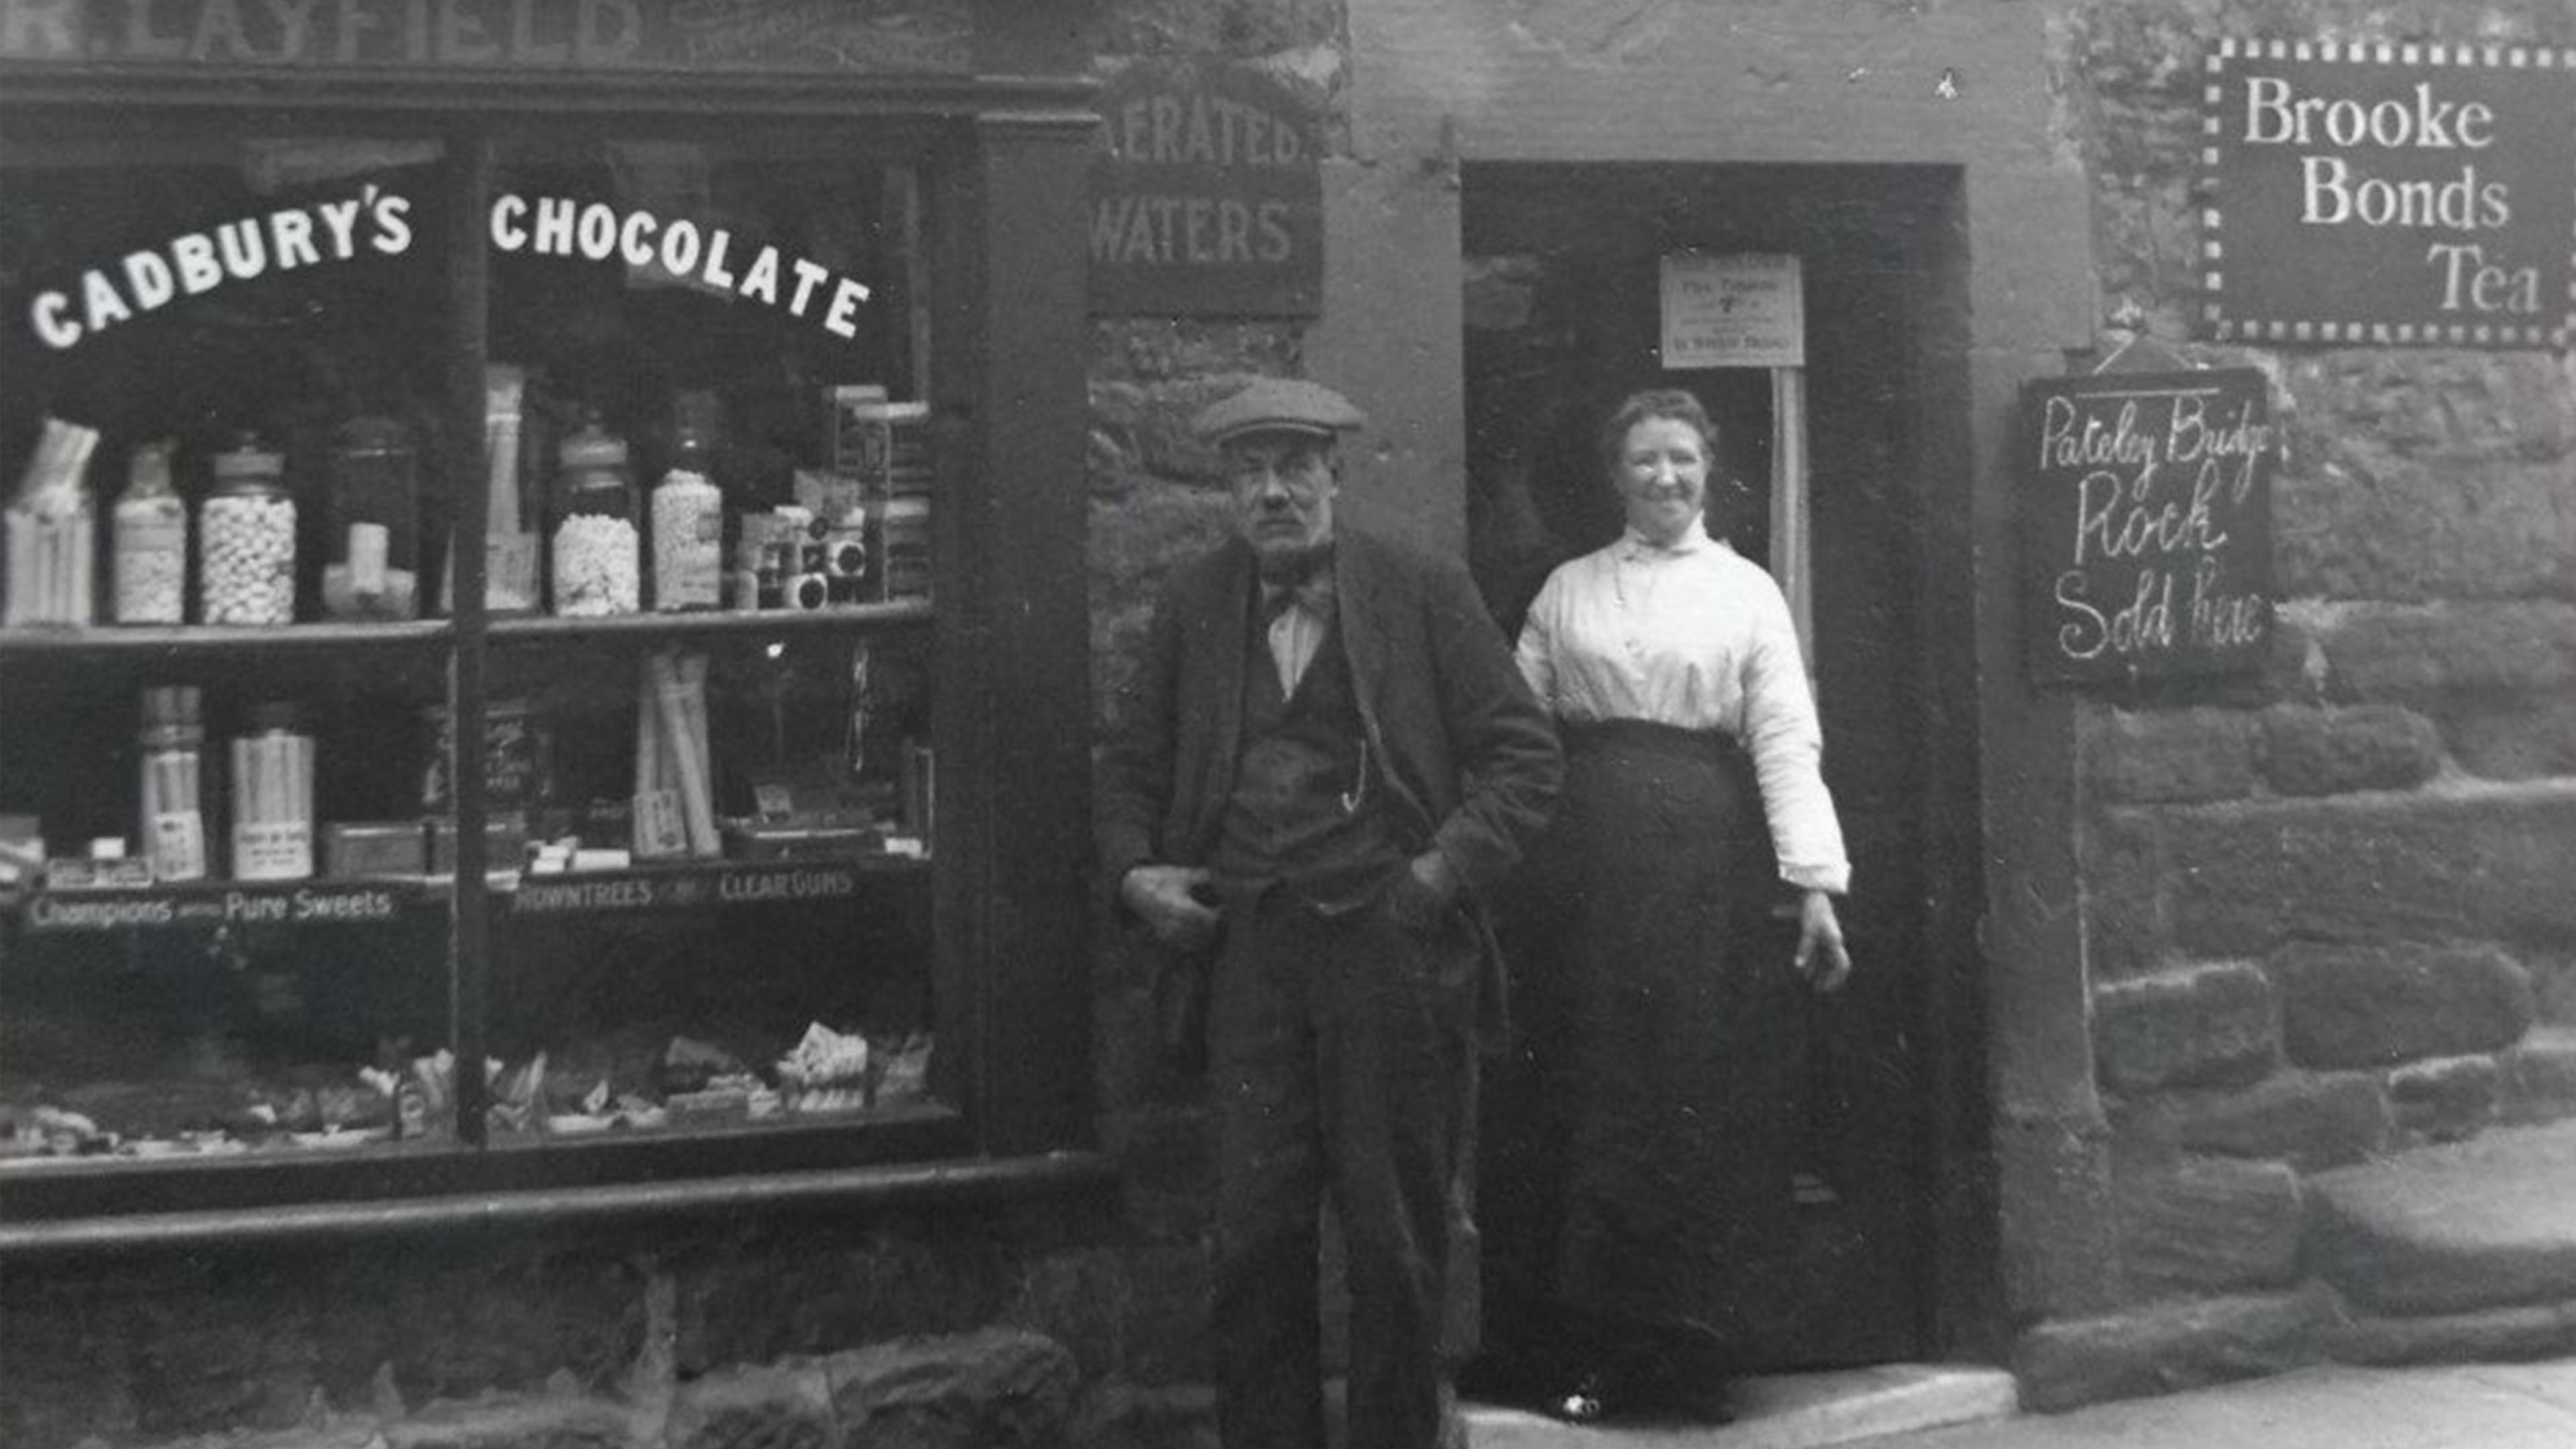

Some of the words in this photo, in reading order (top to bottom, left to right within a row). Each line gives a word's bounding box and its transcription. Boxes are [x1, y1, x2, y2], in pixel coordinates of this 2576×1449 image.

[125, 0, 641, 63] LAYFIELD
[2243, 76, 2494, 147] Brooke
[1087, 195, 1291, 263] WATERS
[2300, 155, 2511, 230] Bonds
[31, 185, 413, 349] CADBURY'S
[490, 193, 871, 339] CHOCOLATE
[2426, 243, 2542, 313] Tea
[2040, 395, 2158, 501] Pateley
[2166, 394, 2271, 504] Bridge
[2075, 458, 2229, 565] Rock
[2055, 569, 2174, 659] Sold
[2191, 556, 2263, 646] here
[30, 896, 173, 928] Champions
[224, 894, 288, 920] Pure
[294, 890, 391, 918] Sweets
